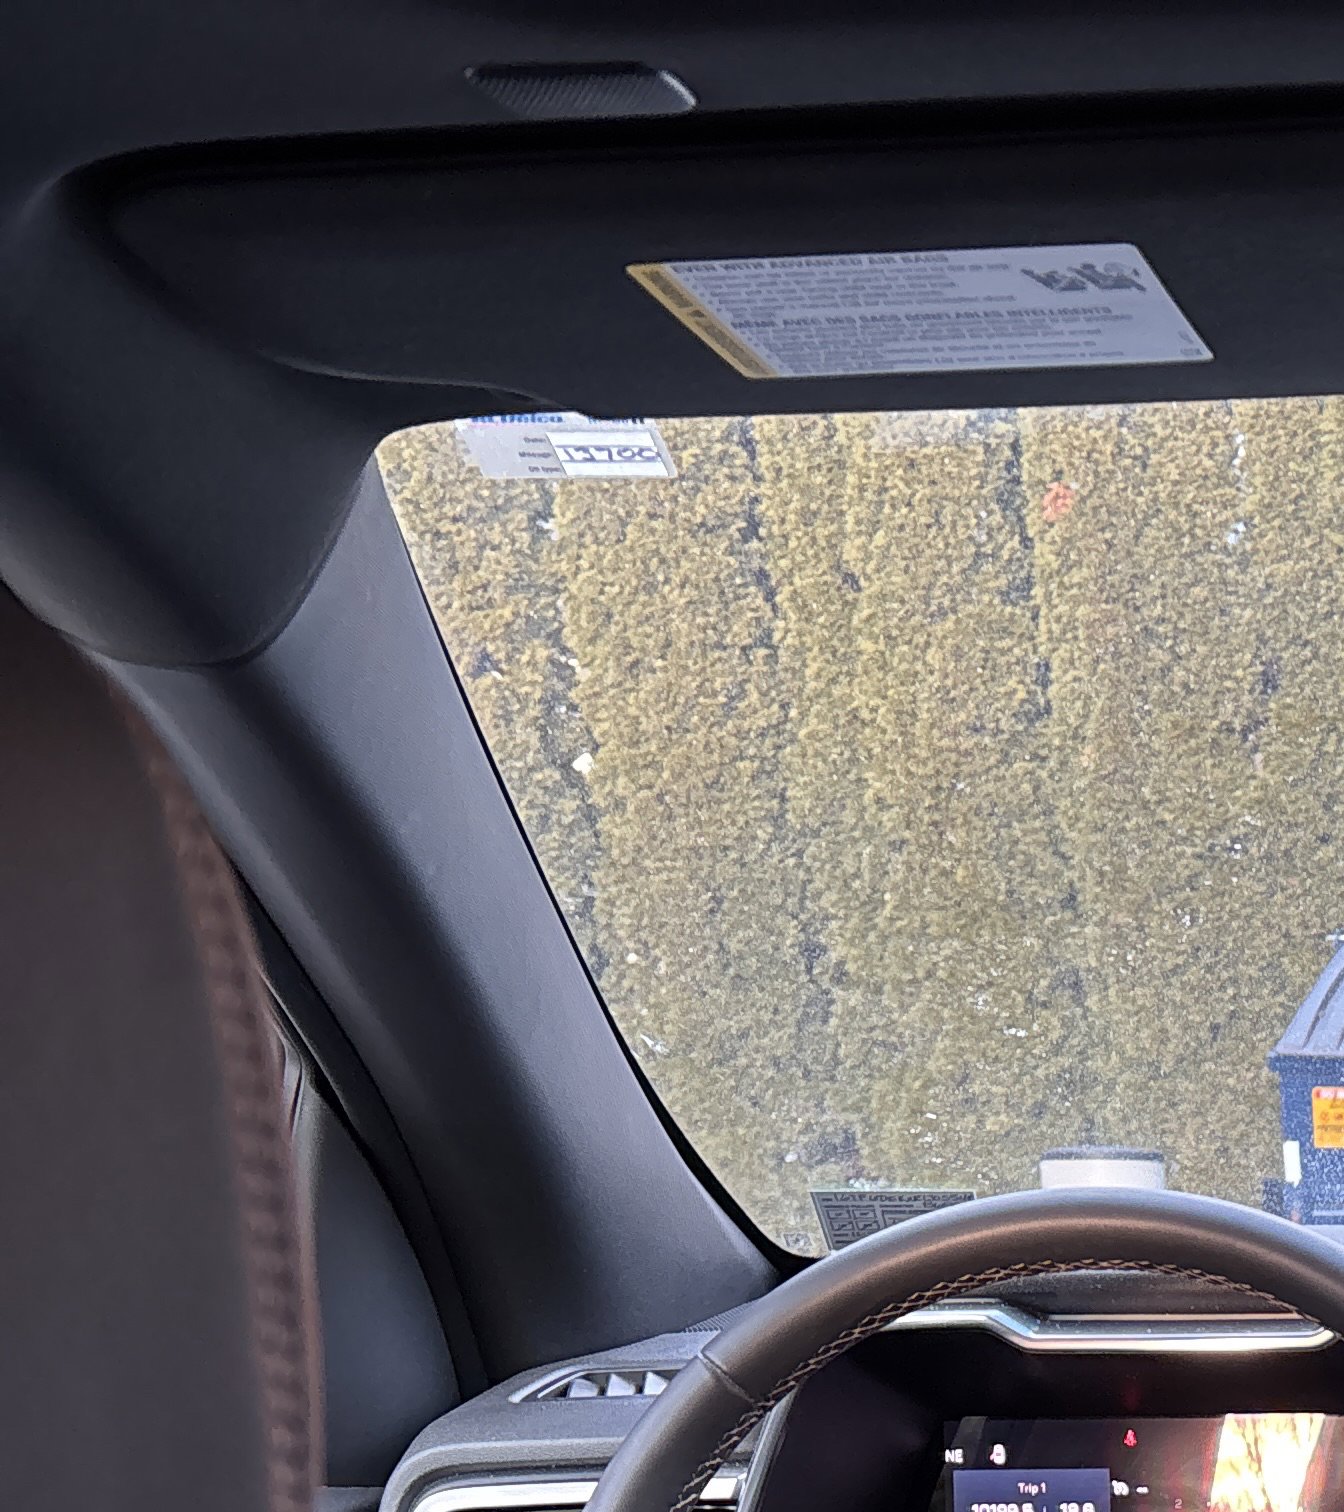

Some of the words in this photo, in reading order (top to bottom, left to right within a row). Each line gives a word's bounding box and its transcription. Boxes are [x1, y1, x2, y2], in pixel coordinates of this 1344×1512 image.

[944, 1448, 964, 1463] NE
[1018, 1482, 1040, 1496] Trip
[1174, 1498, 1183, 1510] 2
